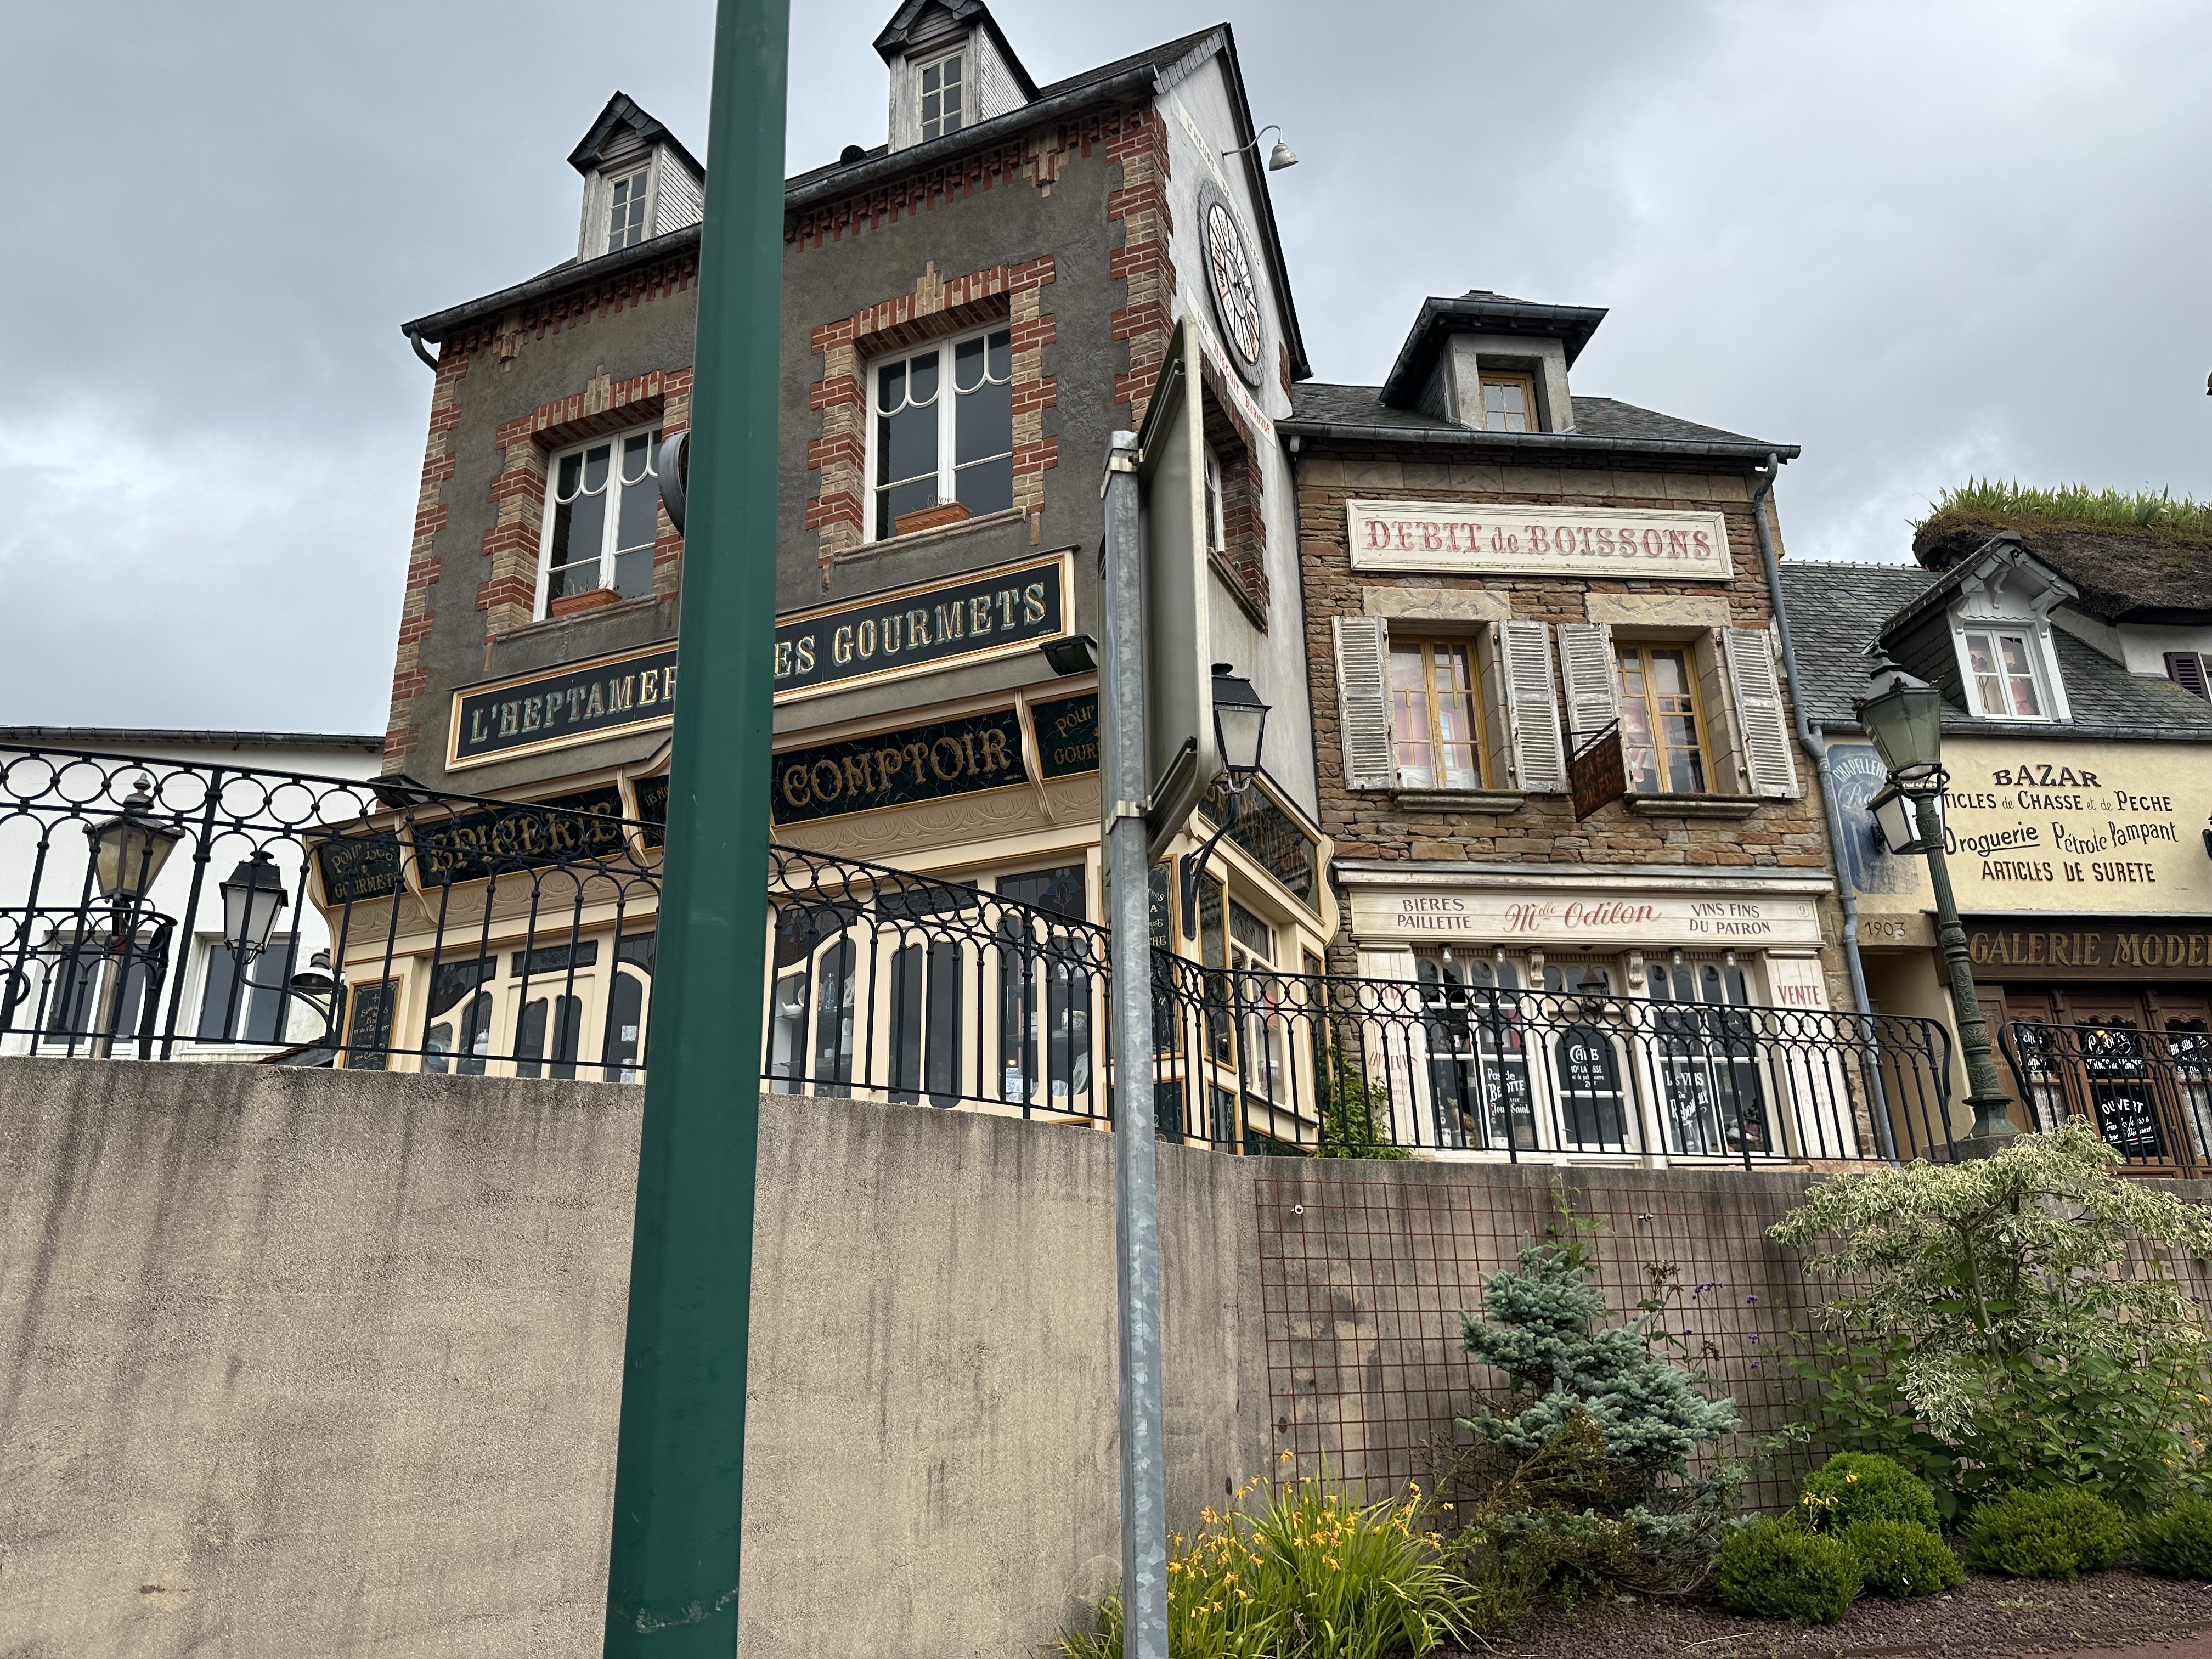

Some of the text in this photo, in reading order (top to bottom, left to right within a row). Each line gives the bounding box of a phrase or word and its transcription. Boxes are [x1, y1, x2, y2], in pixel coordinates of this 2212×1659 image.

[1222, 180, 1231, 201] DE
[1197, 311, 1270, 435] UN BISCUIT BURNOUF
[1364, 519, 1712, 559] DEBIT de BOISSONS
[470, 582, 1047, 744] L'HEPTAMER ES GOURMETS
[783, 728, 1011, 807] COMPTOIR
[1832, 757, 1887, 783] CHAPELLERI
[1993, 765, 2102, 788] BAZAR
[1945, 790, 2173, 812] TICLES de CHASSE et de PECHE
[1945, 821, 2040, 857] Droguerie
[2050, 822, 2107, 854] Pétrole
[1981, 860, 2156, 883] ARTICLES DE SURETE
[1397, 914, 1472, 929] PAILLETTE
[1564, 901, 1662, 929] Odilon
[1691, 902, 1760, 918] VINS FINS
[1798, 905, 1806, 916] 9
[1689, 918, 1771, 935] DU PATRON
[1864, 921, 1906, 938] 1903
[1969, 932, 2101, 966] GALERIE
[1778, 985, 1821, 1005] VENTE
